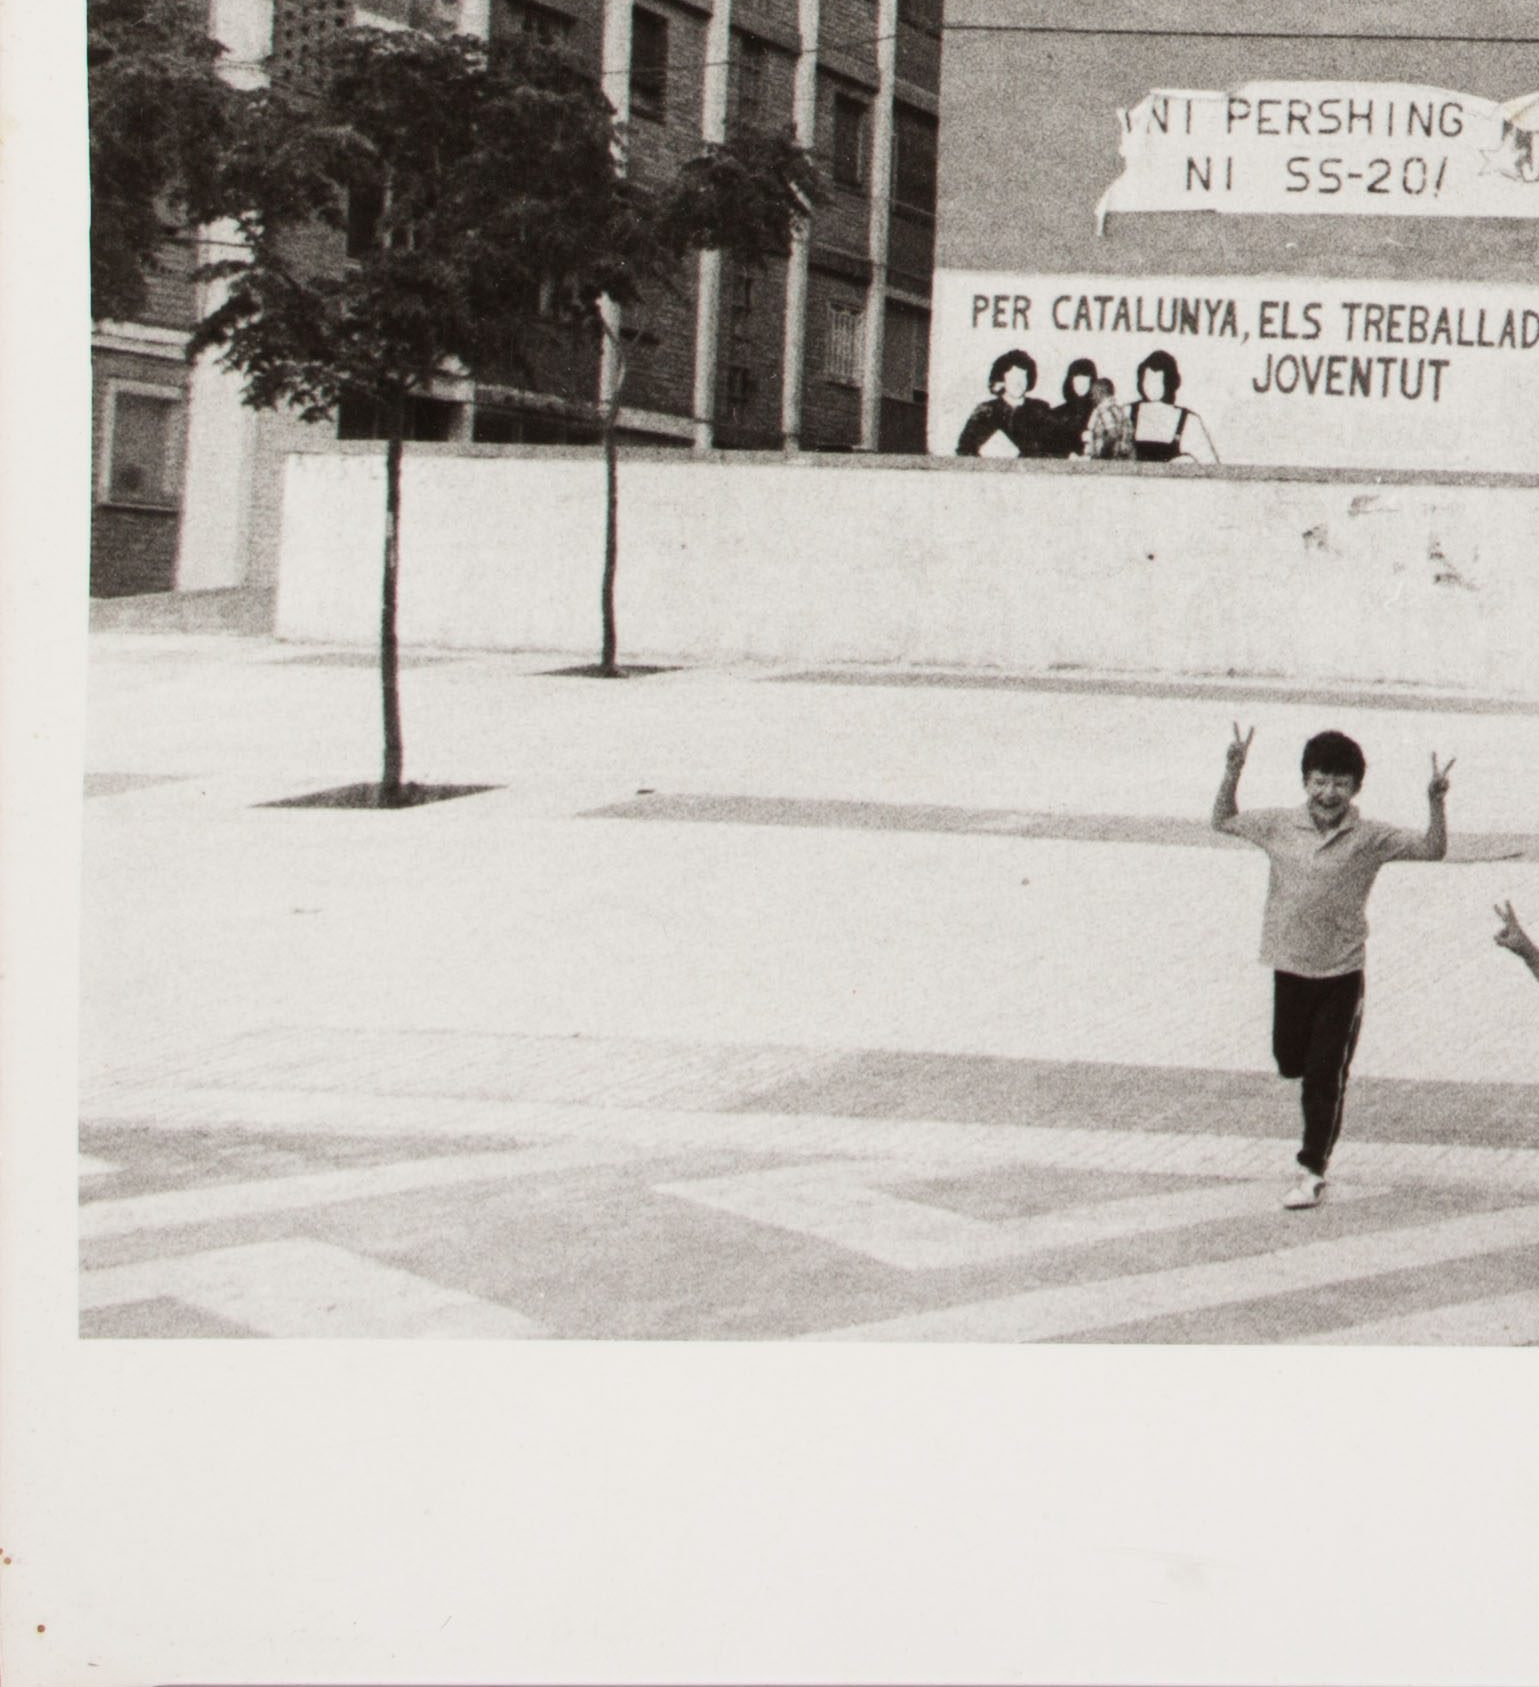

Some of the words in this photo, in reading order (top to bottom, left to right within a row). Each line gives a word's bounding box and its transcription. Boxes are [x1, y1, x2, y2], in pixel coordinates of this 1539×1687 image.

[1227, 97, 1465, 138] PERSHING
[1185, 156, 1233, 192] NI
[971, 293, 1033, 331] PER
[1052, 294, 1251, 345] CATALUNYA,
[1258, 299, 1324, 340] ELS
[1252, 352, 1452, 402] JOVENTUT
